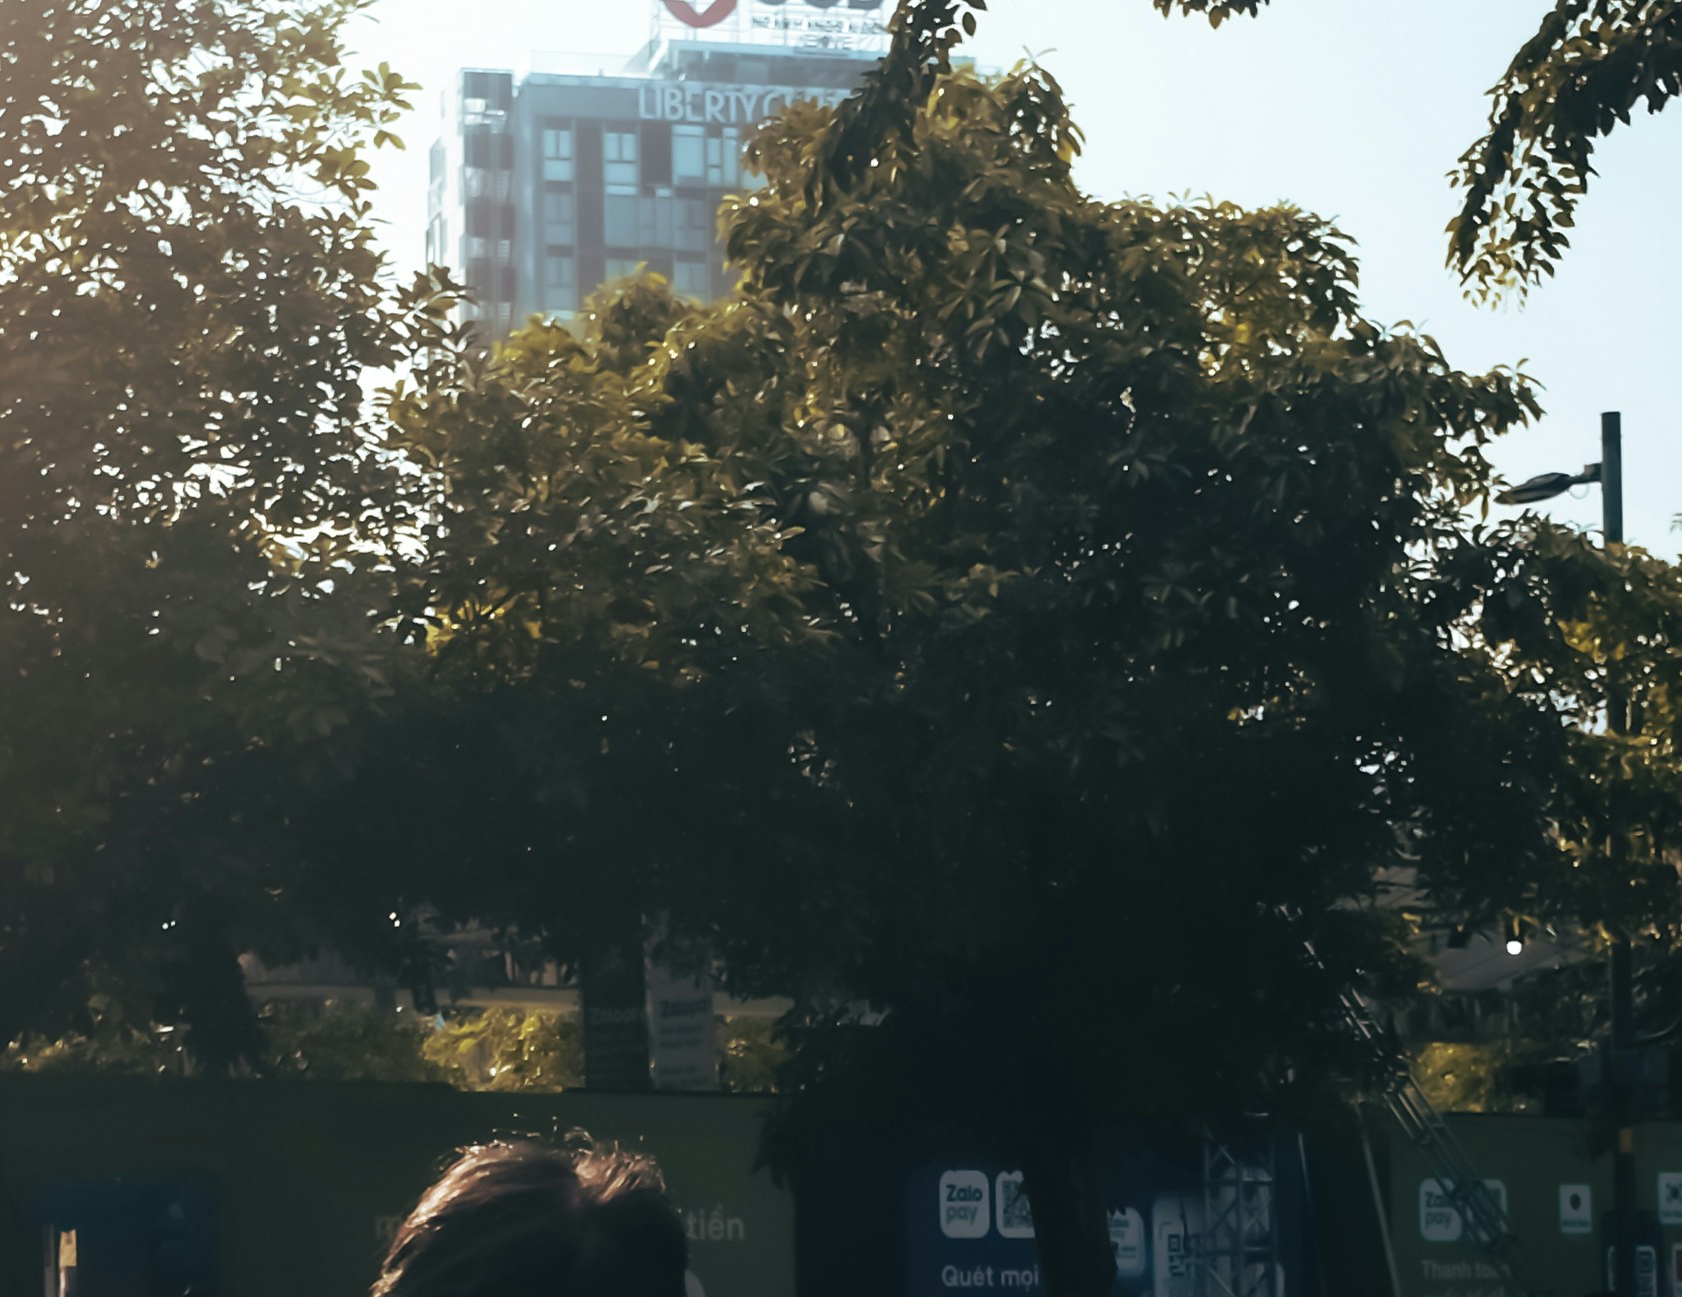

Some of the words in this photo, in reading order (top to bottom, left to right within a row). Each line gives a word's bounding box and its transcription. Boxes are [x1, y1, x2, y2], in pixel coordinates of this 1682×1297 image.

[638, 86, 758, 123] LIBERTY
[946, 1184, 983, 1202] Zalo
[946, 1206, 978, 1226] pay
[941, 1264, 994, 1287] Quét
[1000, 1263, 1040, 1292] mọi
